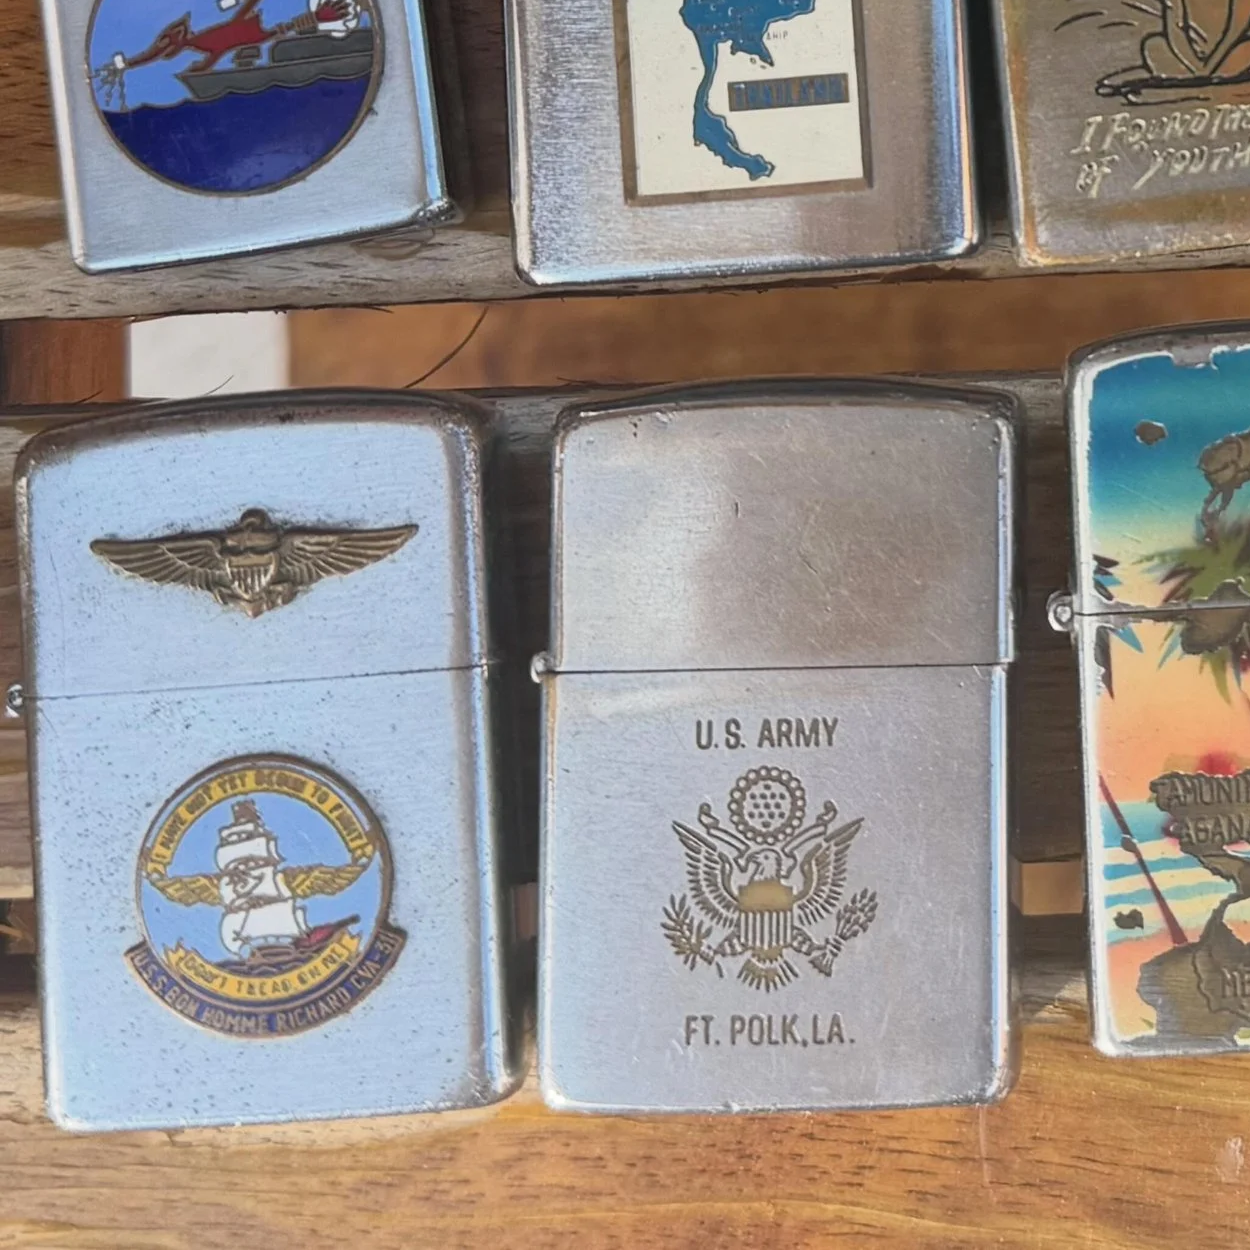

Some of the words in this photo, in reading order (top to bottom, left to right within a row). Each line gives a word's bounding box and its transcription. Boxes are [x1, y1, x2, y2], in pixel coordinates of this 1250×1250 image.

[1071, 114, 1104, 154] I
[1102, 108, 1211, 152] FOUND
[695, 717, 747, 750] U.S.
[757, 716, 839, 749] ARMY
[219, 773, 249, 793] YET
[310, 784, 332, 805] TO
[165, 986, 198, 1019] BON
[202, 1005, 270, 1035] HOMME
[276, 988, 354, 1033] RICHARD
[354, 932, 399, 991] CVA-31
[236, 977, 292, 997] TREAD
[298, 966, 323, 987] ON
[684, 1014, 722, 1047] FT.
